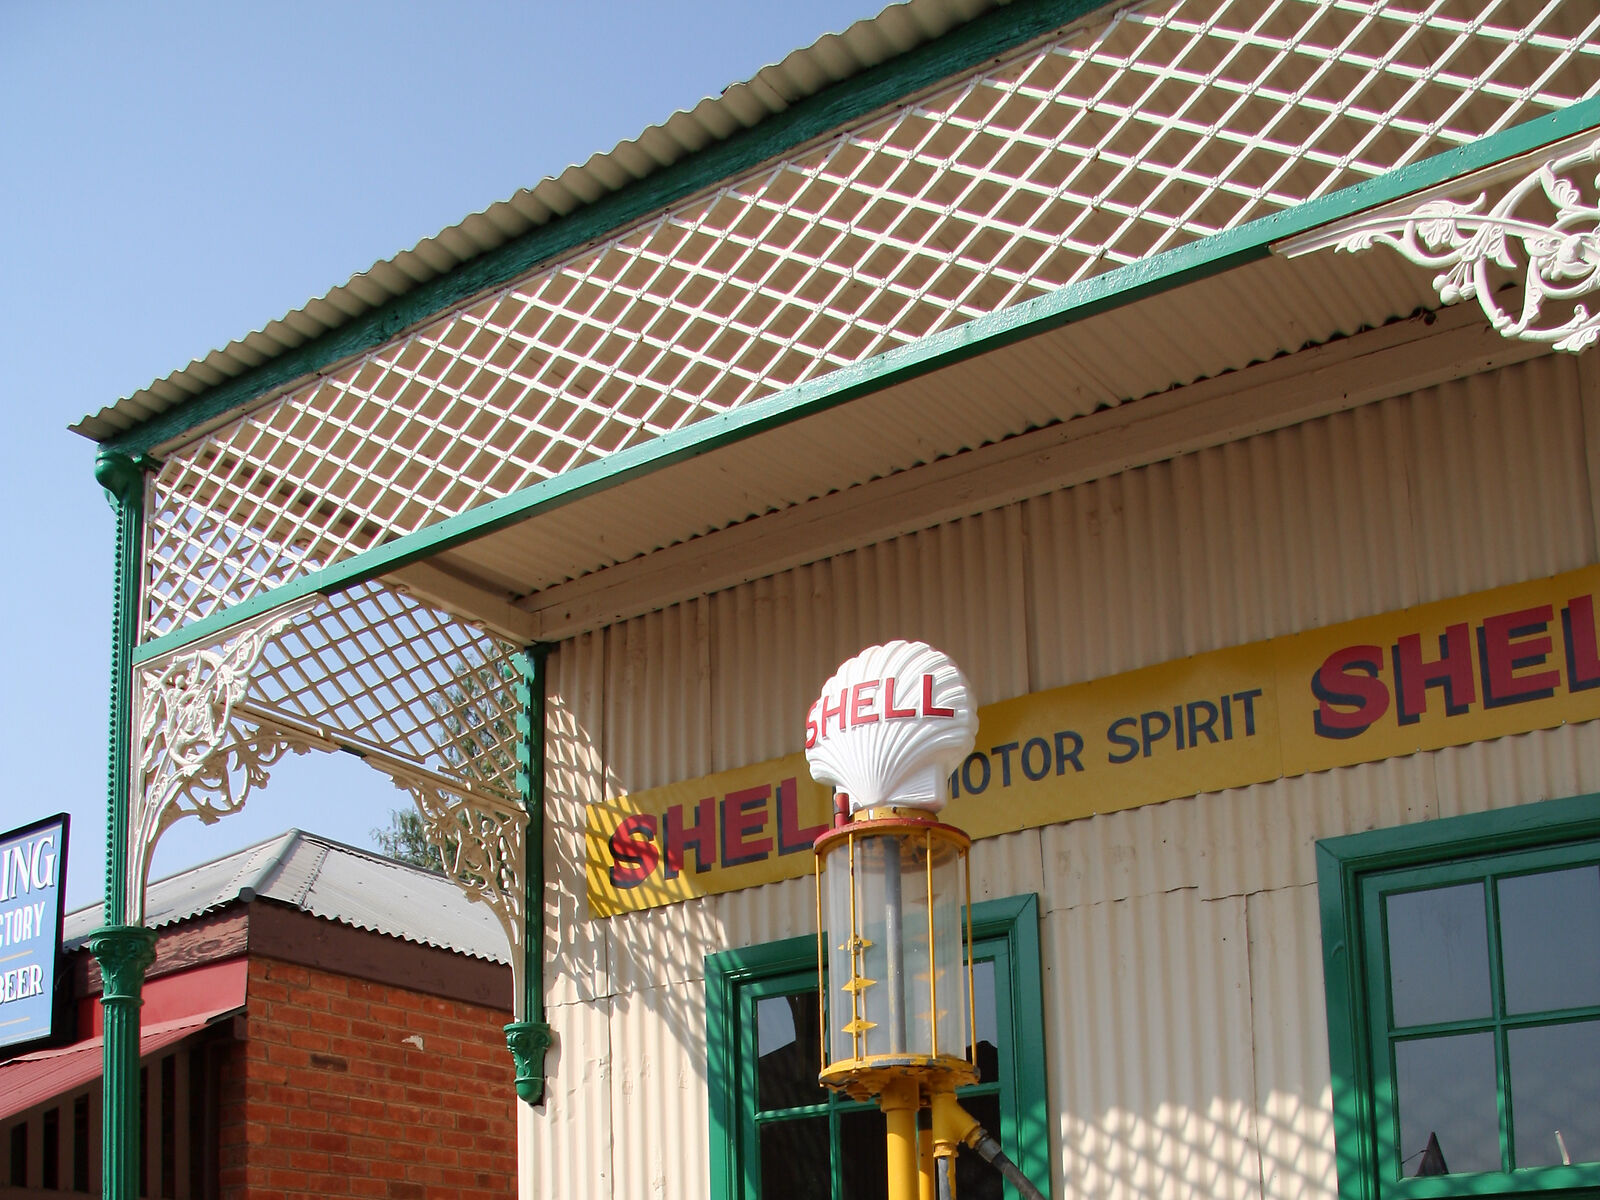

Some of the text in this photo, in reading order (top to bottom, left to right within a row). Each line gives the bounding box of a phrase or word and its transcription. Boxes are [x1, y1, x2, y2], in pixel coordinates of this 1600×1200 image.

[805, 674, 954, 749] SHELL
[609, 777, 838, 889] SHEL
[1106, 688, 1263, 764] SPIRIT
